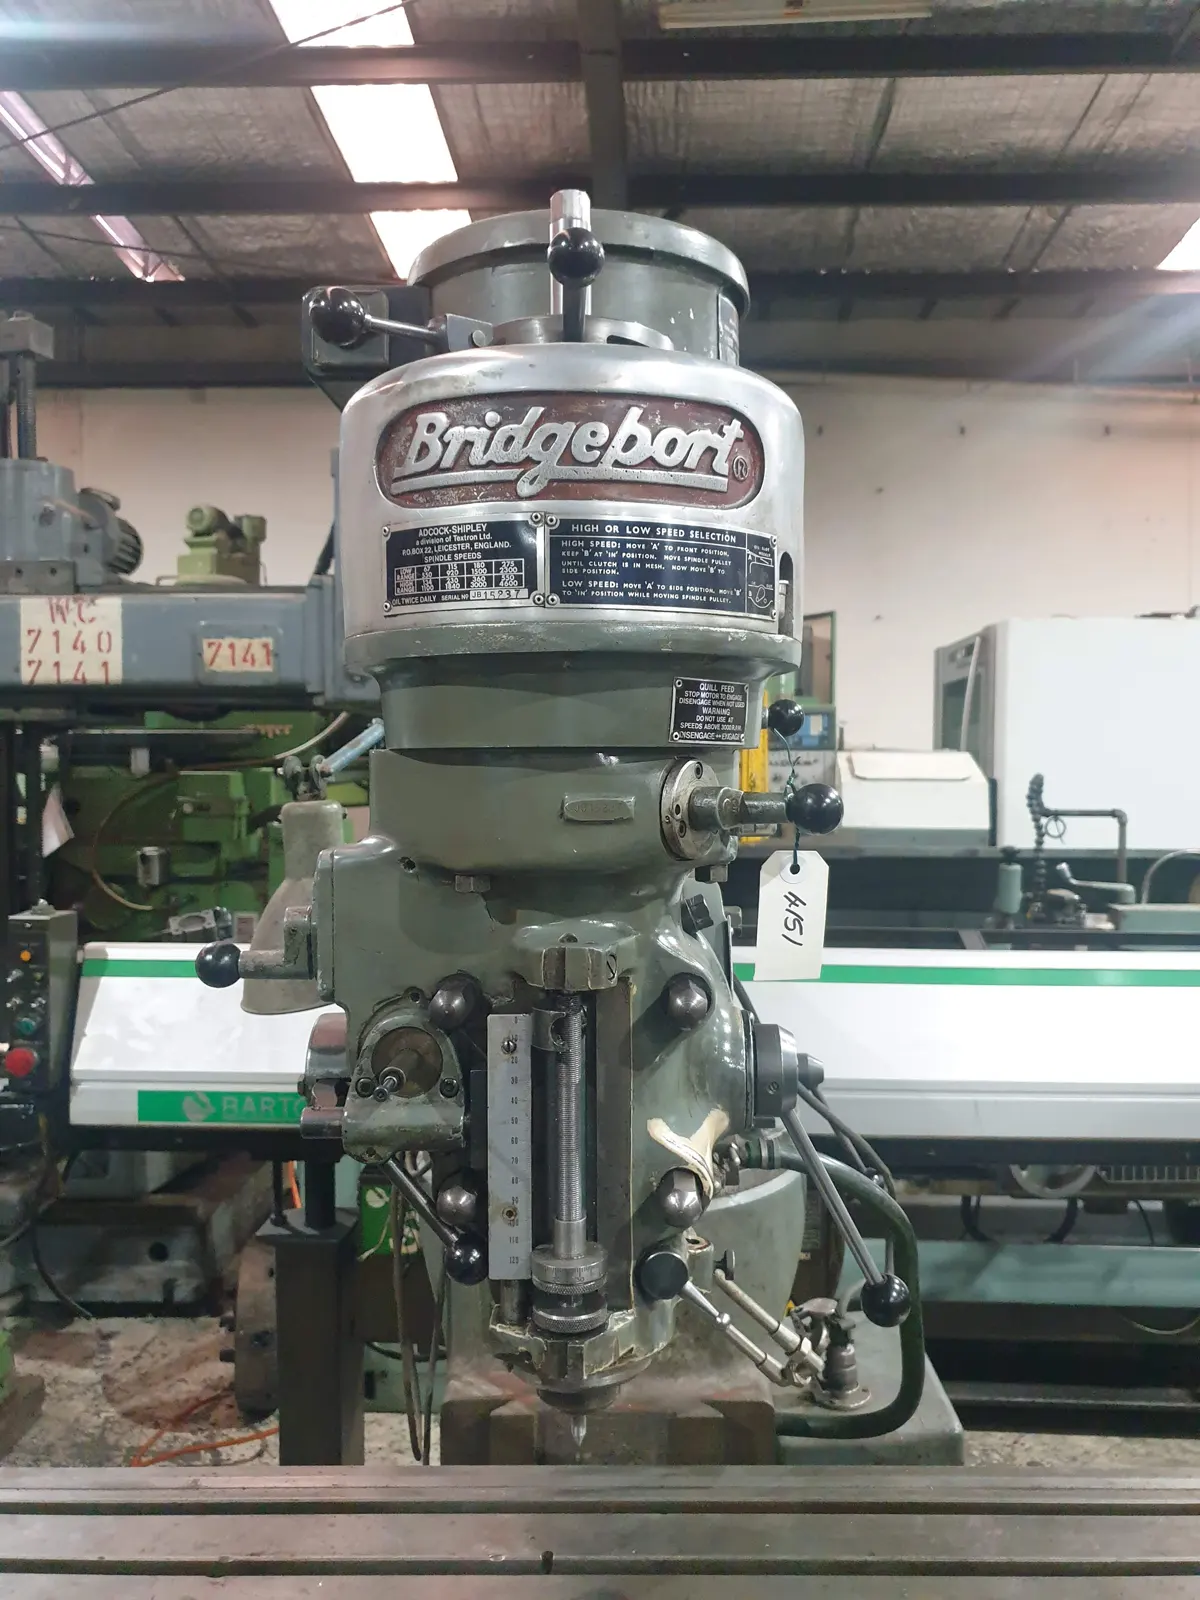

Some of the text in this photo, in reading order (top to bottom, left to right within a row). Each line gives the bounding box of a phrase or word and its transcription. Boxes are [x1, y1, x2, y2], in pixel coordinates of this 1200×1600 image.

[391, 406, 744, 498] Bridgeport
[418, 523, 487, 537] ADCOCK-SHIPLEY
[571, 524, 737, 543] HIGH OR LOW SPEED SELECTION
[420, 537, 444, 546] division
[453, 534, 478, 542] Textron
[589, 541, 621, 549] SPEED:
[434, 542, 473, 552] LEICESTER,
[474, 541, 512, 549] ENGLAND.
[424, 552, 482, 563] SPINDLE SPEEDS
[622, 552, 657, 560] POSITION.
[499, 566, 518, 574] 2300
[499, 580, 518, 588] 4600
[562, 580, 583, 588] LOW
[588, 580, 619, 588] SPEED:
[392, 598, 401, 606] OIL
[401, 597, 419, 605] TWICE
[420, 595, 437, 603] DAILY
[441, 594, 460, 602] SERIAL
[681, 594, 707, 602] SPINDLE
[26, 629, 112, 654] 7140
[206, 642, 273, 667] 7141
[26, 660, 110, 685] 7141
[699, 683, 735, 693] QUILL FEED
[684, 690, 700, 698] STOP
[679, 697, 711, 706] DISENGAGE
[702, 706, 731, 716] WARNING
[695, 714, 704, 722] DO
[679, 722, 703, 730] SPEEDS
[680, 731, 715, 740] DISENGAGE
